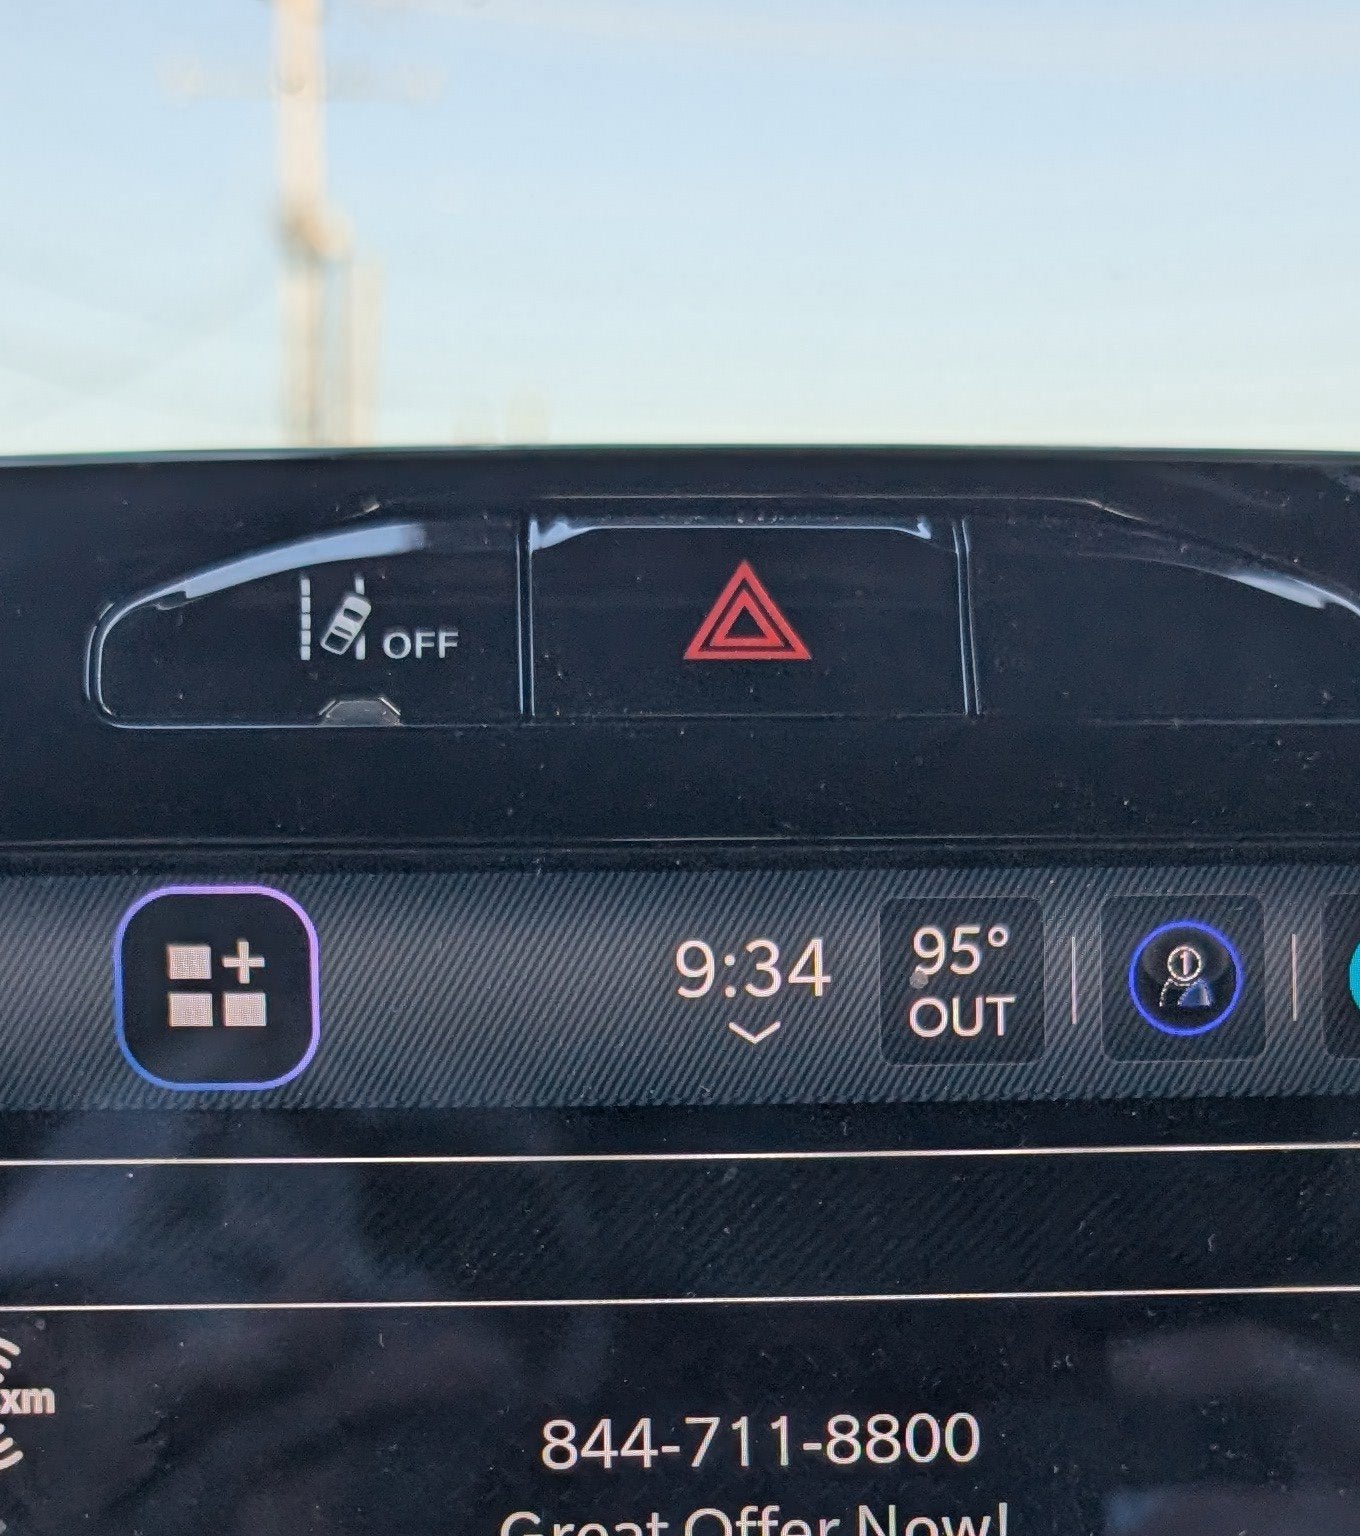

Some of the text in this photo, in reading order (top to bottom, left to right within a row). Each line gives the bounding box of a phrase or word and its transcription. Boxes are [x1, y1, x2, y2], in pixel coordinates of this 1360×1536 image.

[383, 630, 460, 660] OFF
[674, 937, 832, 1000] 9:34
[912, 924, 1010, 978] 95°
[908, 995, 1016, 1038] OUT
[541, 1411, 981, 1472] 844-711-8800
